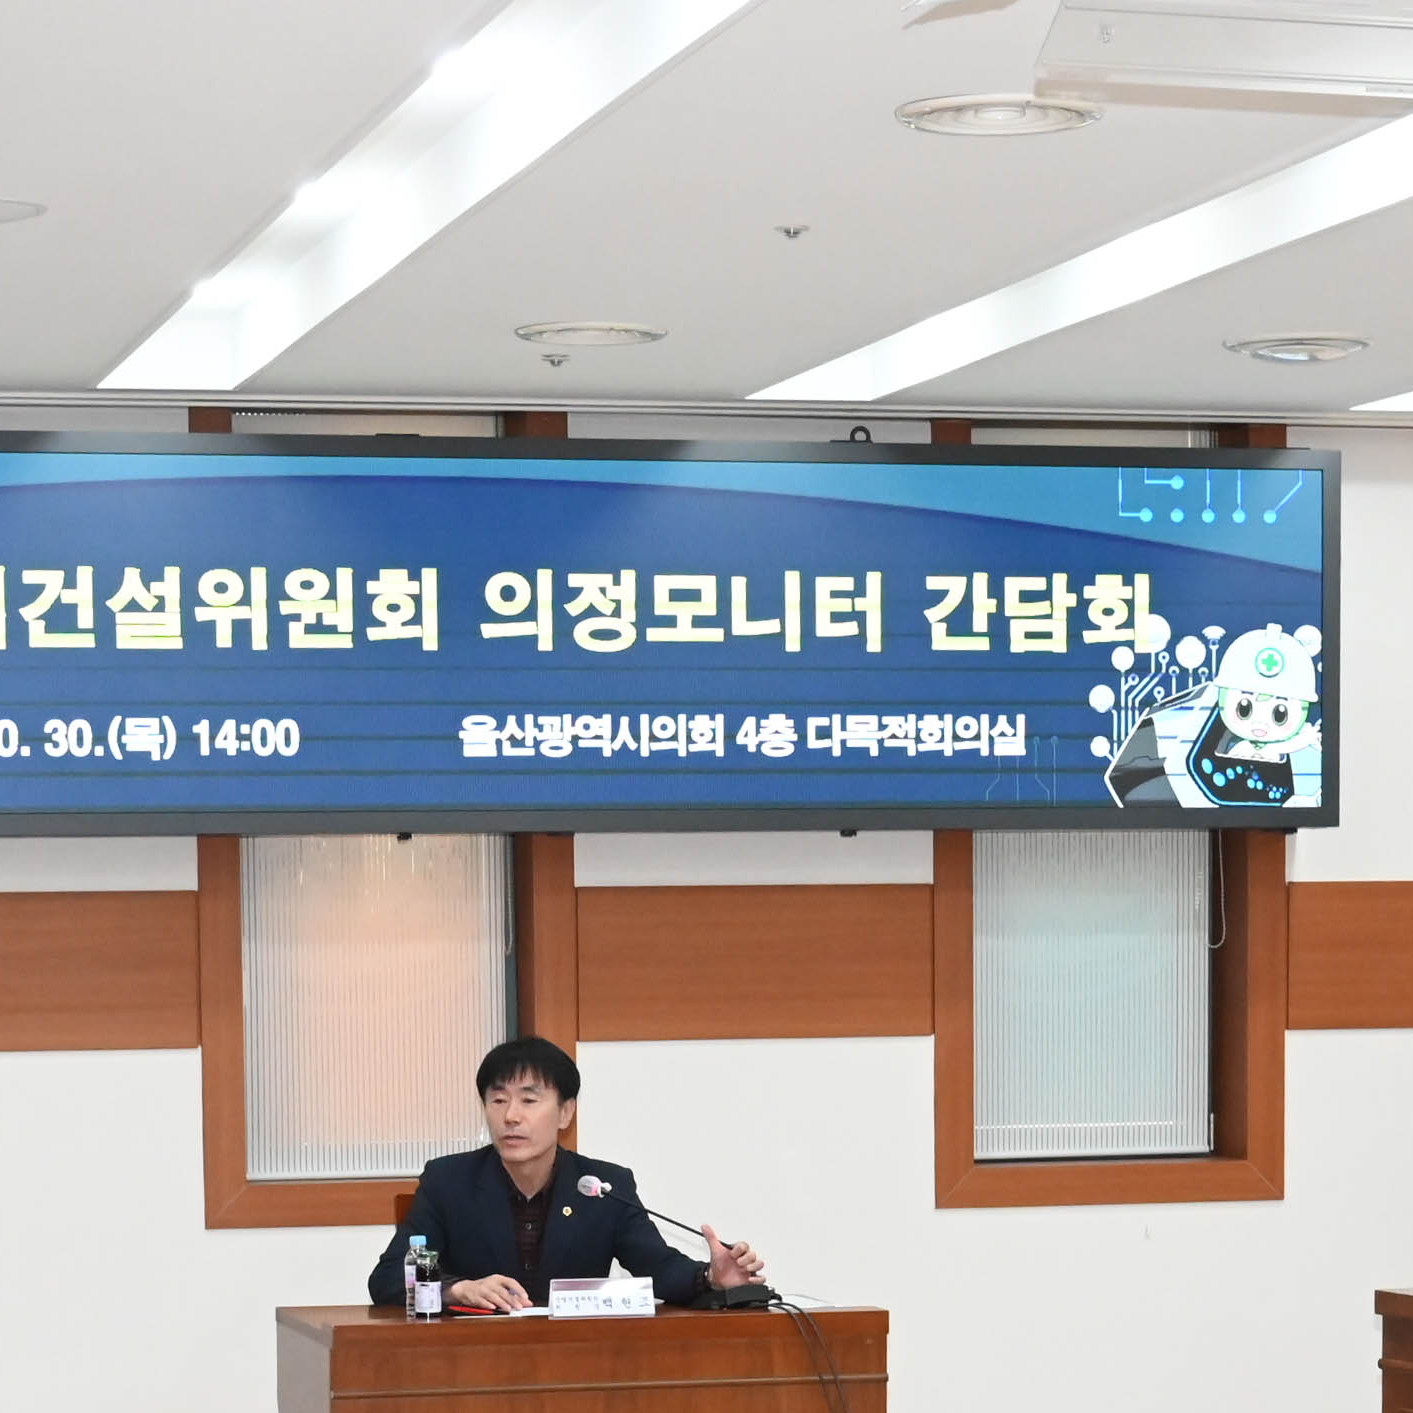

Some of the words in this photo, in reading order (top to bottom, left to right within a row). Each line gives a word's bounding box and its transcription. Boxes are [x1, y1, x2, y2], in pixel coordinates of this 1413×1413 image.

[480, 568, 882, 653] 의정모니터
[923, 572, 1150, 654] 간담회
[43, 715, 178, 761] 30.(목)
[191, 718, 301, 758] 14:00
[458, 713, 725, 758] 울산광역시의회
[735, 713, 798, 758] 4층
[806, 713, 1027, 757] 다목적회의실
